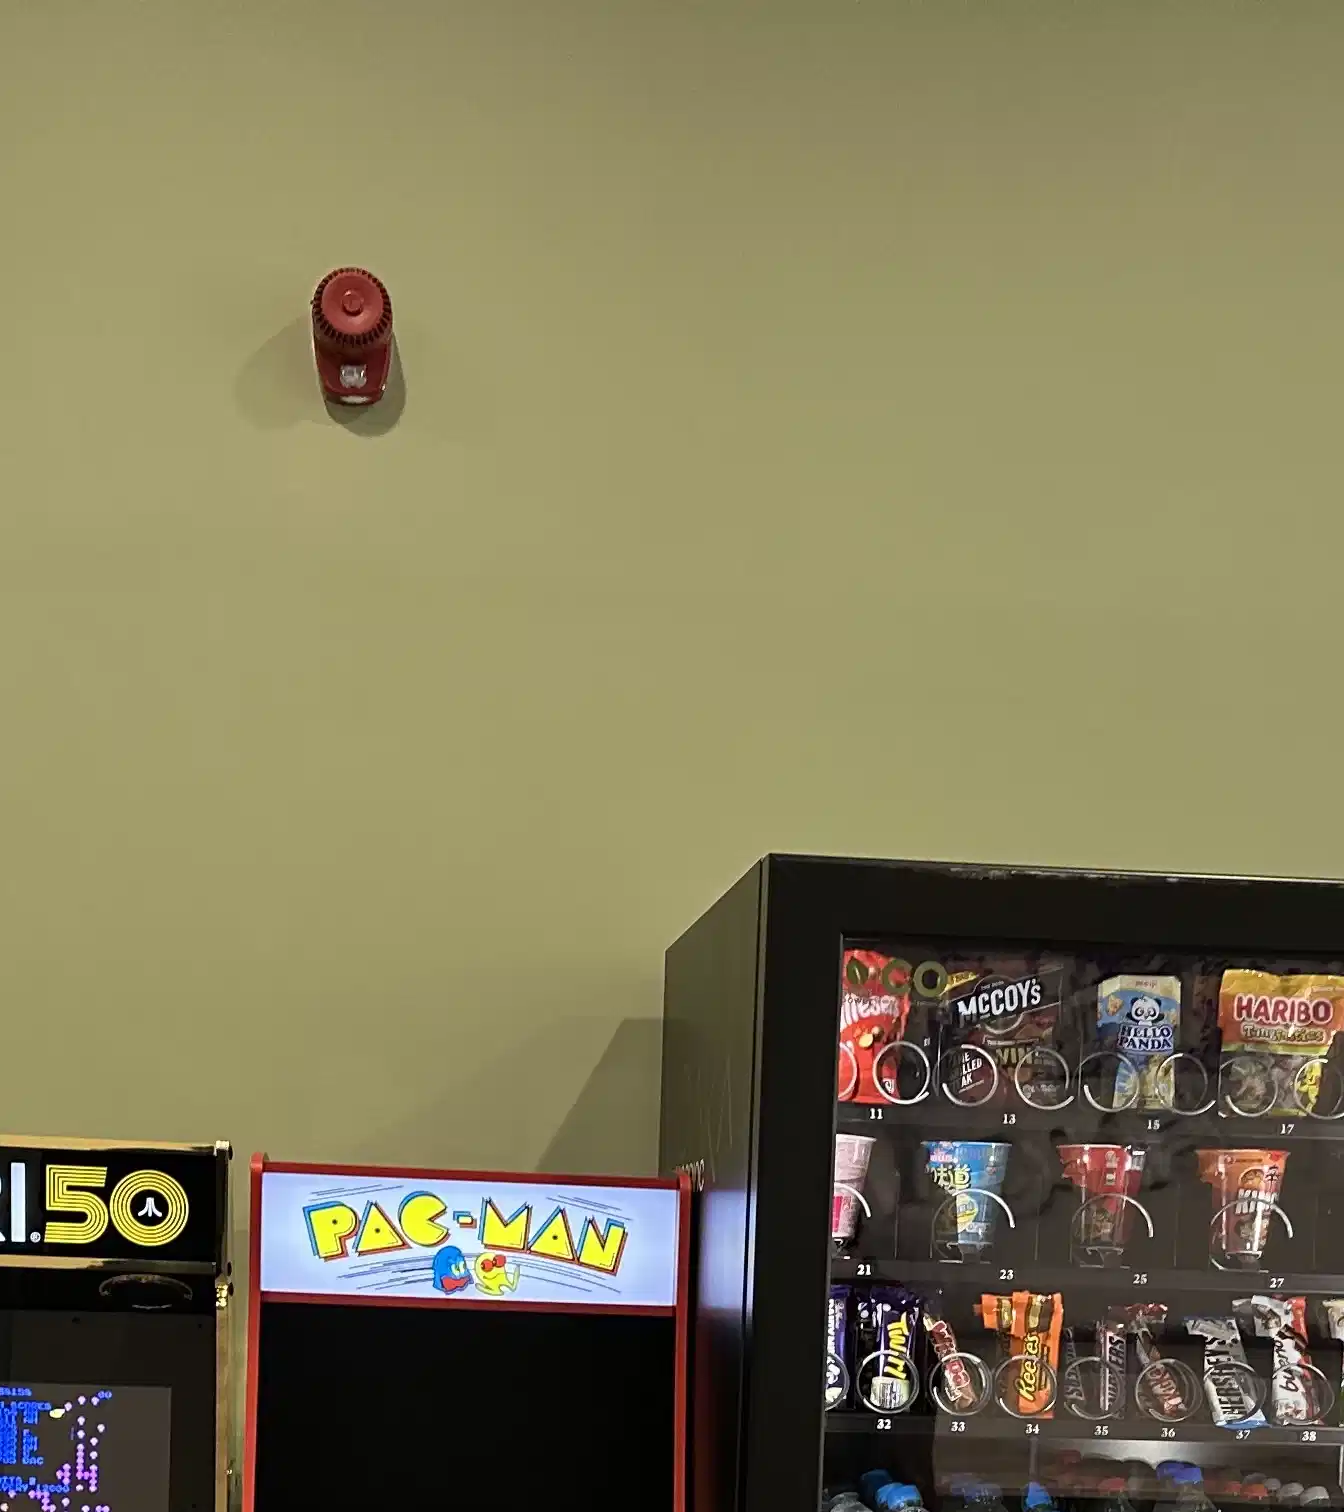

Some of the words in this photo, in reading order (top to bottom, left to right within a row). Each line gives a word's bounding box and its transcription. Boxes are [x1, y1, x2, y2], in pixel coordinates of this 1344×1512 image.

[1235, 995, 1332, 1024] HARIBO
[1121, 1026, 1173, 1039] HELLO
[1119, 1037, 1172, 1050] PANDA
[869, 1108, 883, 1120] 11
[1003, 1113, 1017, 1124] 13
[1147, 1119, 1160, 1130] 15
[1280, 1123, 1295, 1135] 17
[302, 1191, 629, 1275] PAC-MAN
[857, 1264, 871, 1275] 21
[999, 1270, 1014, 1280] 23
[1133, 1274, 1148, 1285] 25
[1270, 1278, 1284, 1289] 27
[1273, 1339, 1299, 1393] bueno
[876, 1419, 892, 1430] 32
[951, 1421, 966, 1432] 33
[1025, 1424, 1040, 1435] 34
[1094, 1425, 1109, 1436] 35
[1161, 1427, 1176, 1438] 36
[1235, 1430, 1250, 1440] 37
[1301, 1431, 1317, 1442] 38
